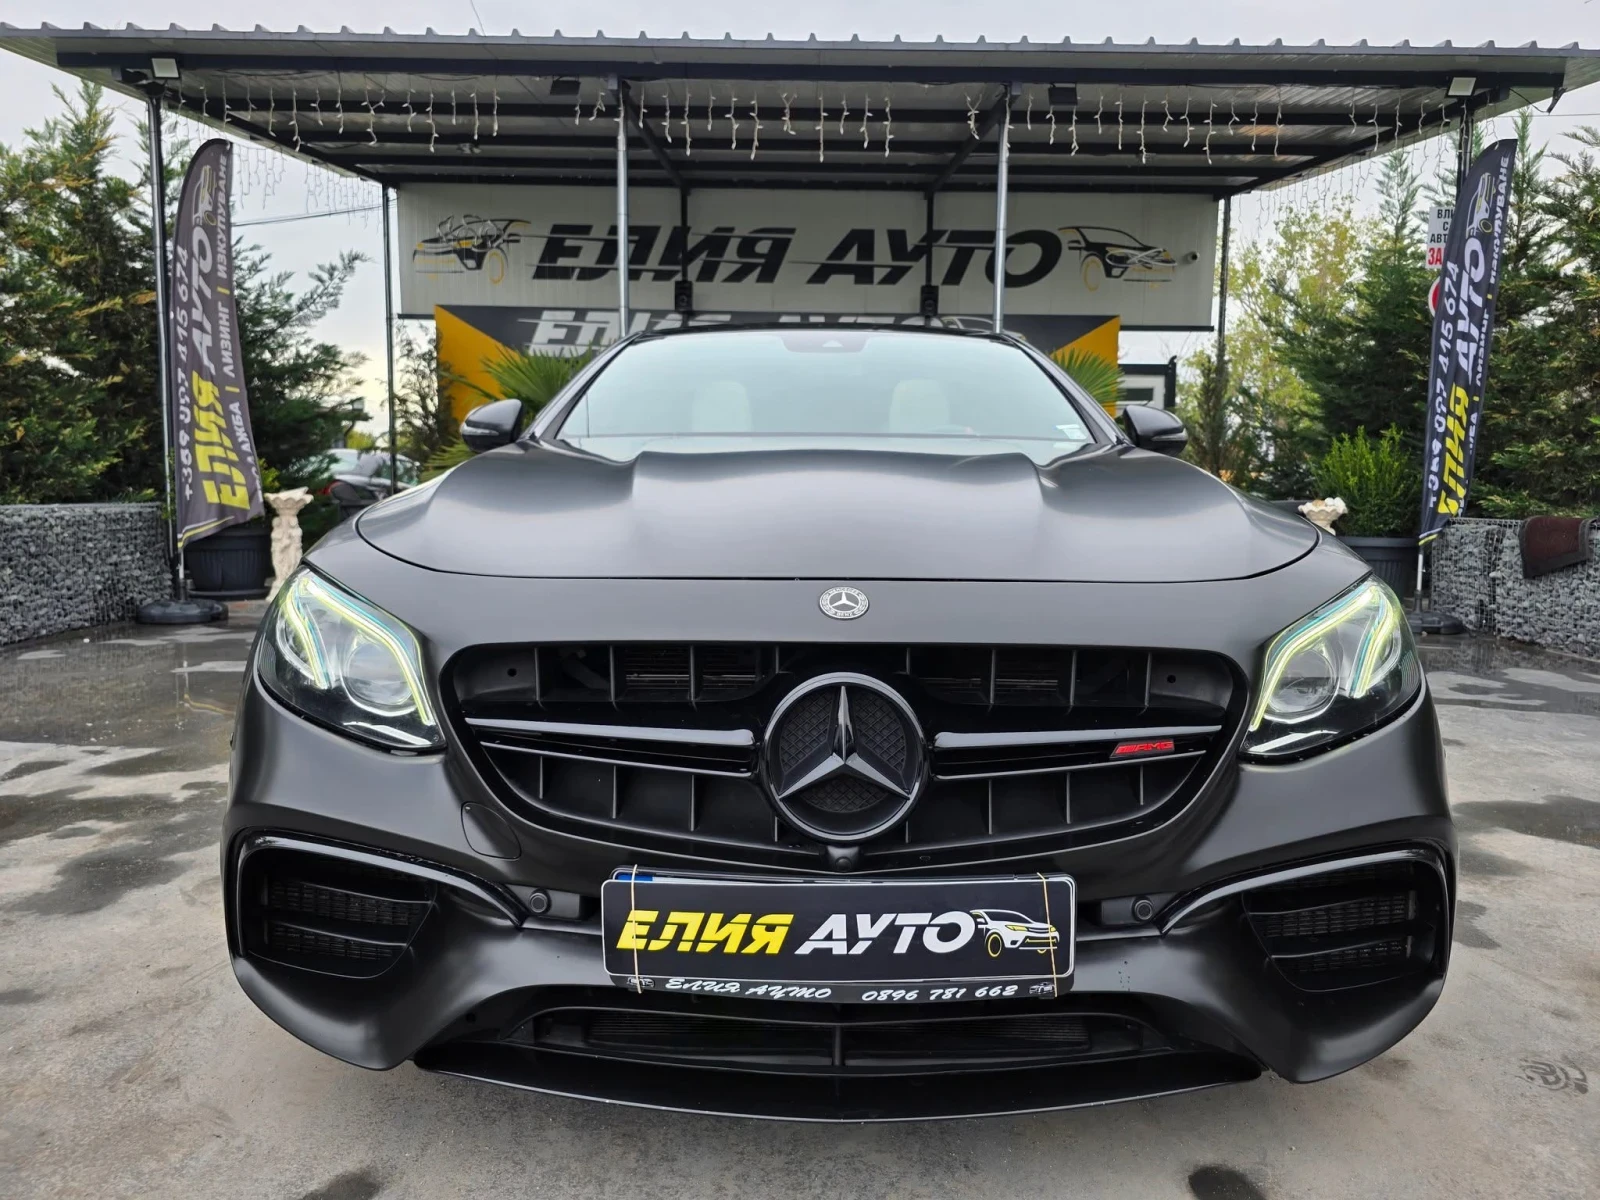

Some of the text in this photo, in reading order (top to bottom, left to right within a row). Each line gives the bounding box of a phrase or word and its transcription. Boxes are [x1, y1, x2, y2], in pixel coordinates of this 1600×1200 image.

[176, 245, 188, 302] 674
[532, 224, 1062, 288] ЕЛИЯ АУТО
[1445, 261, 1458, 316] 674
[1456, 237, 1485, 386] АУТО
[177, 306, 188, 362] 415
[218, 301, 235, 378] ЛИЗИНГ
[1439, 320, 1453, 374] 415
[192, 226, 250, 510] ЕЛИЯ АУТО
[616, 909, 975, 955] ЕЛИЯ АУТО
[861, 988, 920, 1001] 0896
[929, 987, 967, 1000] 781
[975, 985, 1019, 998] 662
